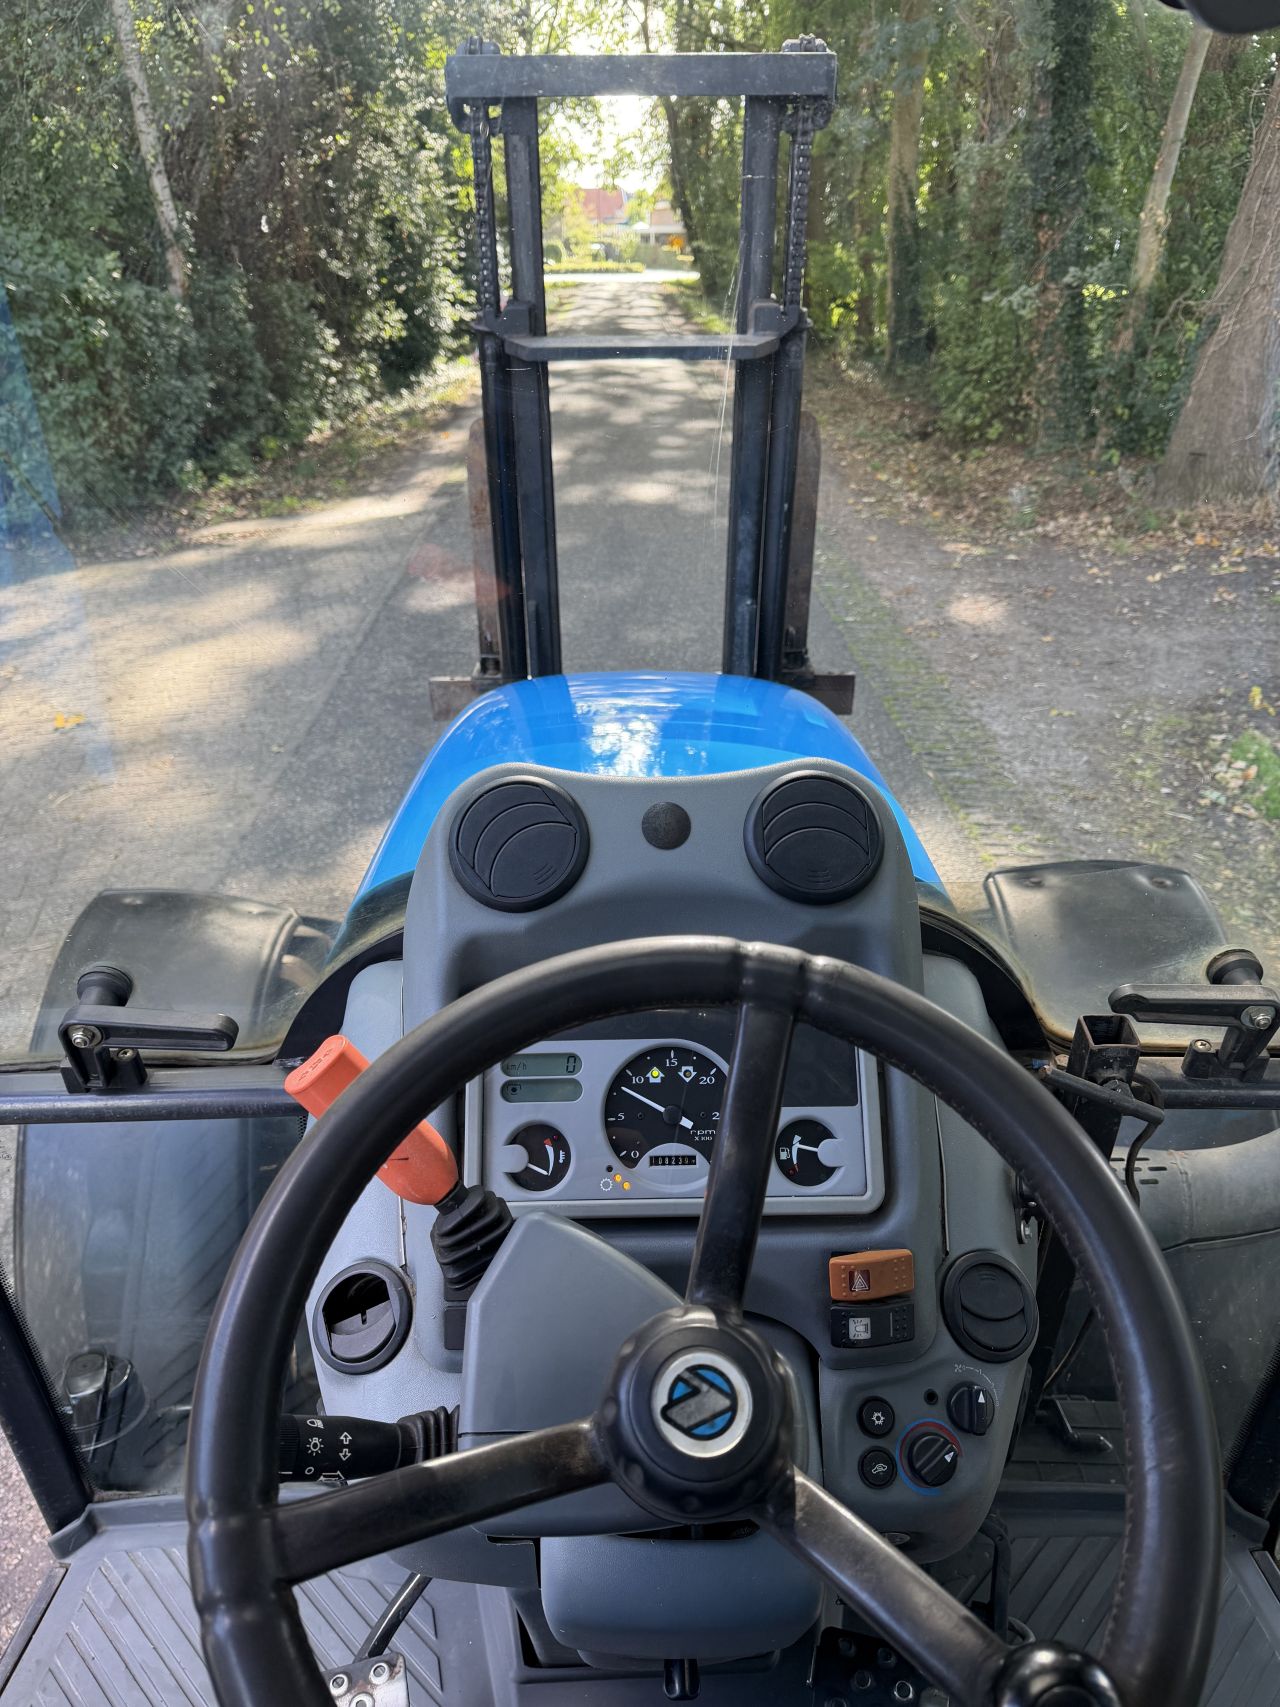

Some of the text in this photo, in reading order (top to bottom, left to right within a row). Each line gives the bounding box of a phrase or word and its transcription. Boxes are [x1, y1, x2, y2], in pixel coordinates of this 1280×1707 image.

[566, 1055, 577, 1073] 0
[665, 1058, 678, 1067] 15
[632, 1075, 645, 1084] 10
[699, 1076, 715, 1085] 20
[617, 1112, 625, 1121] 5
[712, 1111, 720, 1120] 2
[630, 1150, 640, 1159] 0
